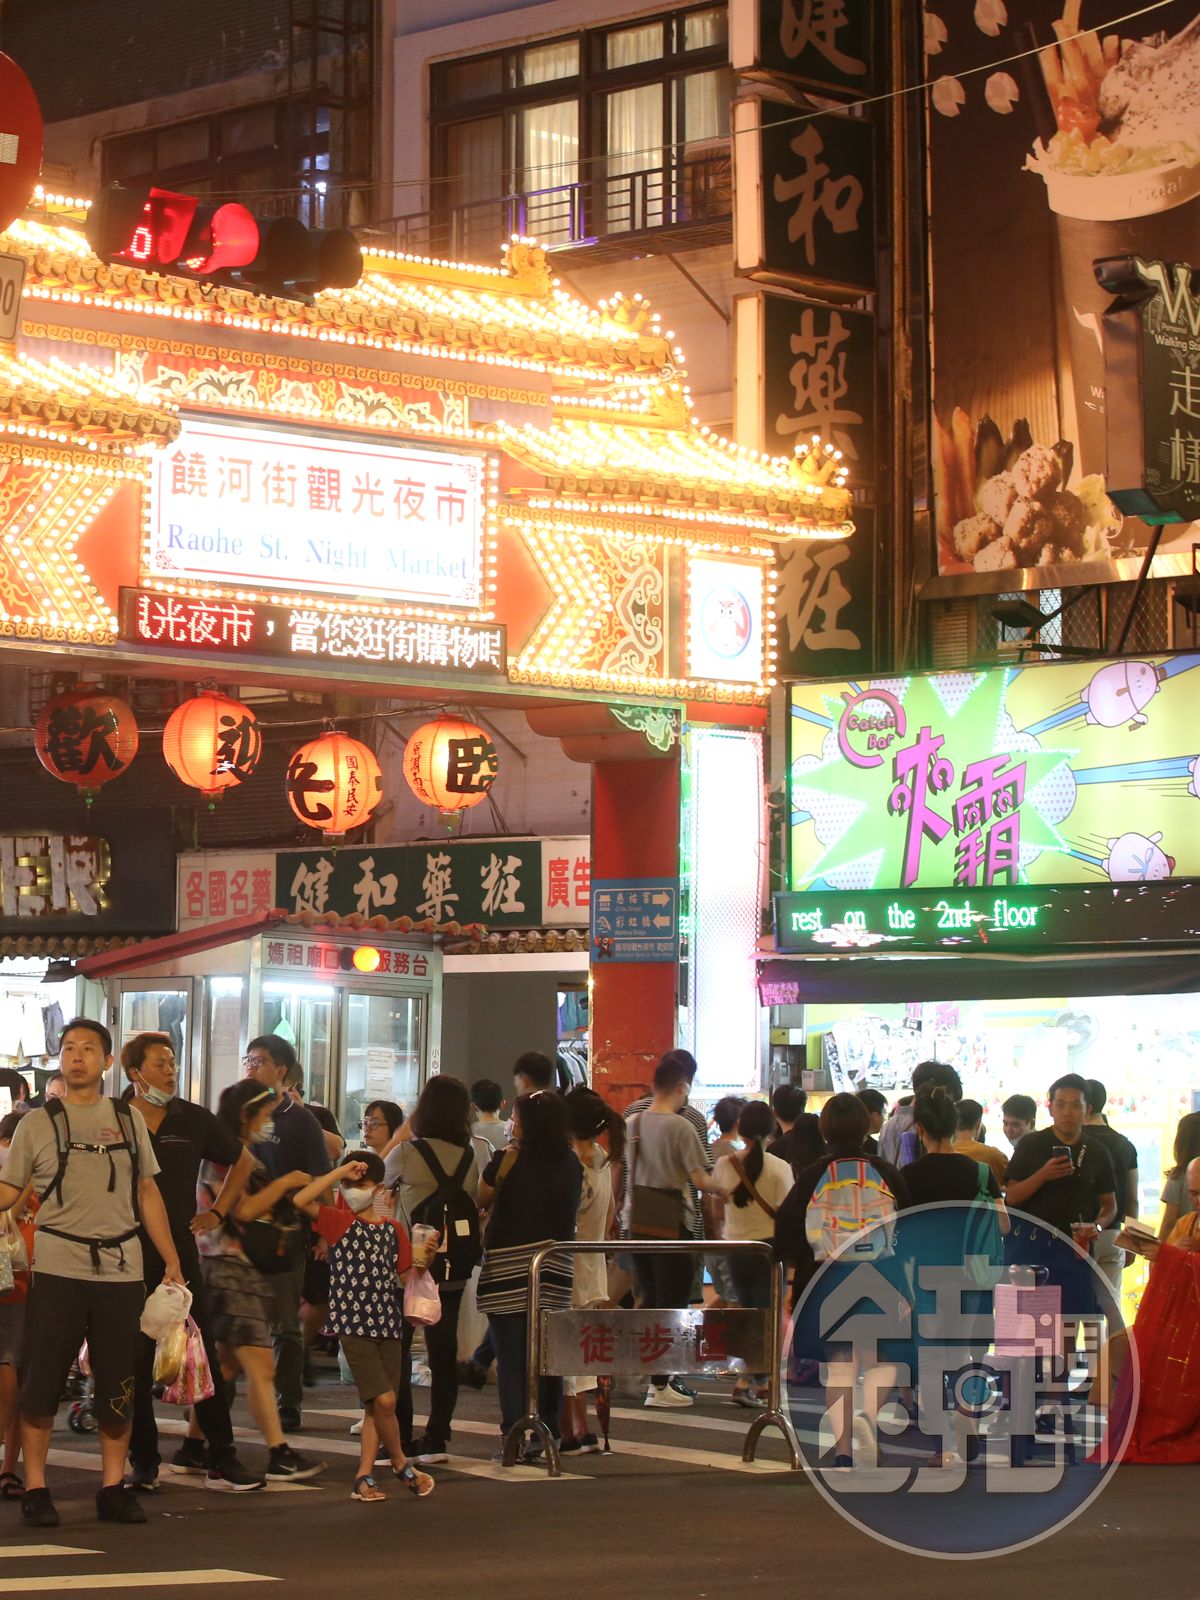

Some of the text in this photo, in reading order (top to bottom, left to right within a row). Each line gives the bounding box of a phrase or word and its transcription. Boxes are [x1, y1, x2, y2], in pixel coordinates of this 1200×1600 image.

[1155, 334, 1188, 352] Walking
[170, 448, 468, 527] 饒河街觀光夜市
[167, 523, 468, 581] Raohe St. Night Market
[43, 705, 124, 776] 歡
[868, 734, 895, 750] Bar
[343, 755, 360, 817] 國泰民安
[186, 868, 272, 918] 各國名藥
[290, 852, 526, 922] 健和藥粧
[792, 901, 1038, 930] rest on the 2nd floor
